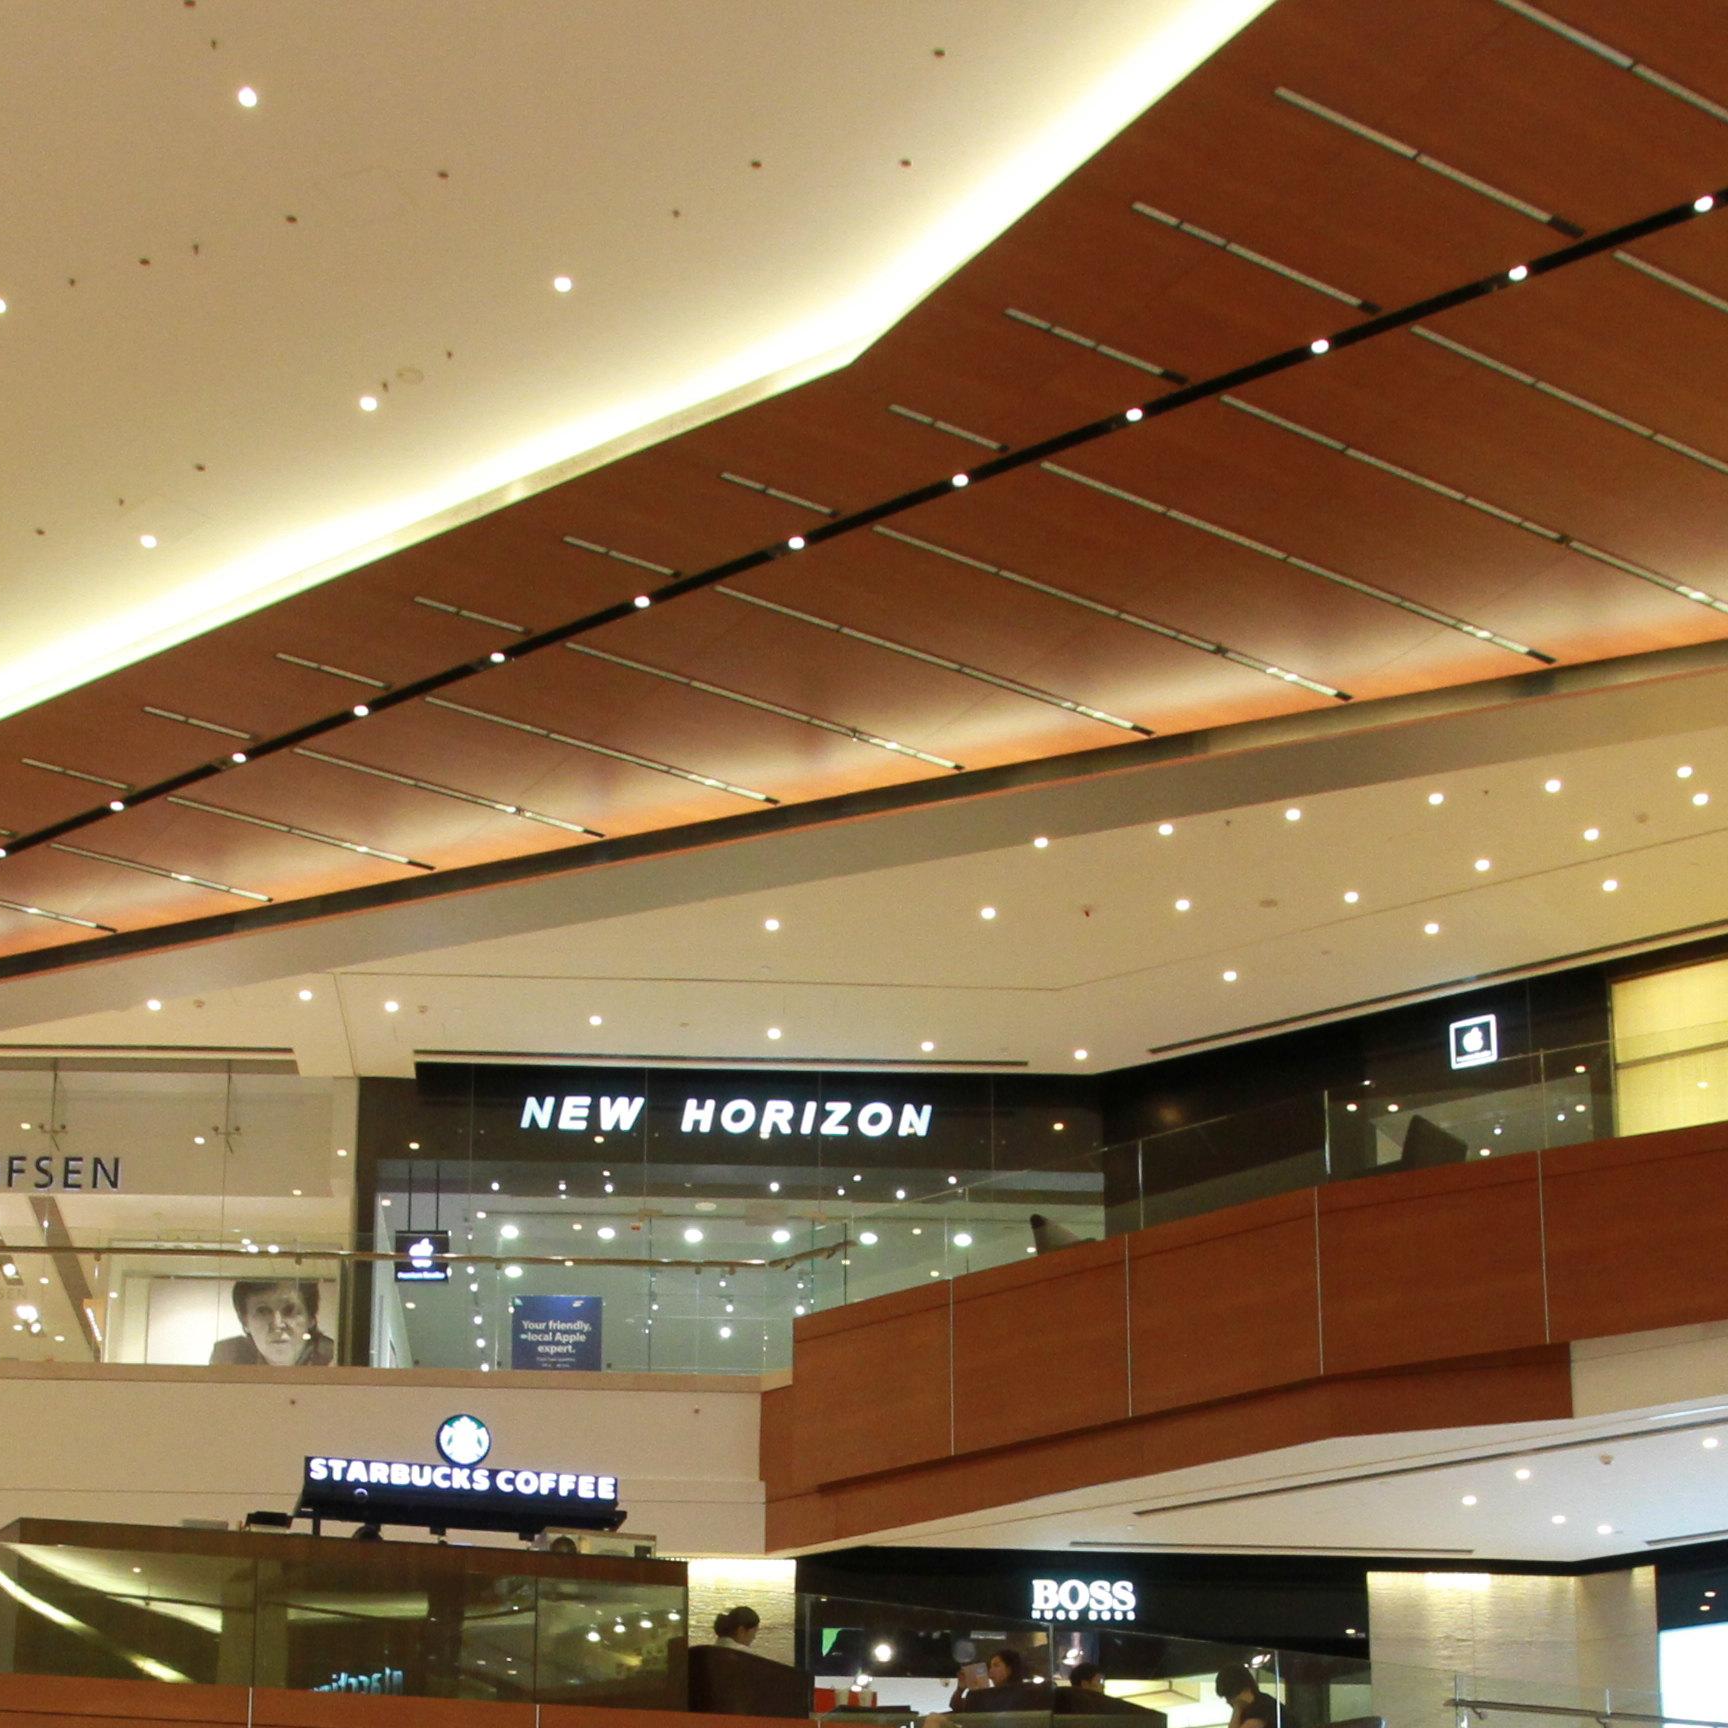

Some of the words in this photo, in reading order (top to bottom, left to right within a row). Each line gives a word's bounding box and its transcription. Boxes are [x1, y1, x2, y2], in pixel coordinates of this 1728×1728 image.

[520, 1096, 645, 1131] NEW
[680, 1098, 933, 1137] HORIZON
[522, 1320, 547, 1330] Your
[554, 1332, 587, 1344] Apple
[309, 1457, 490, 1491] STARBUCKS
[495, 1469, 616, 1499] COFFEE
[1031, 1579, 1136, 1611] BOSS
